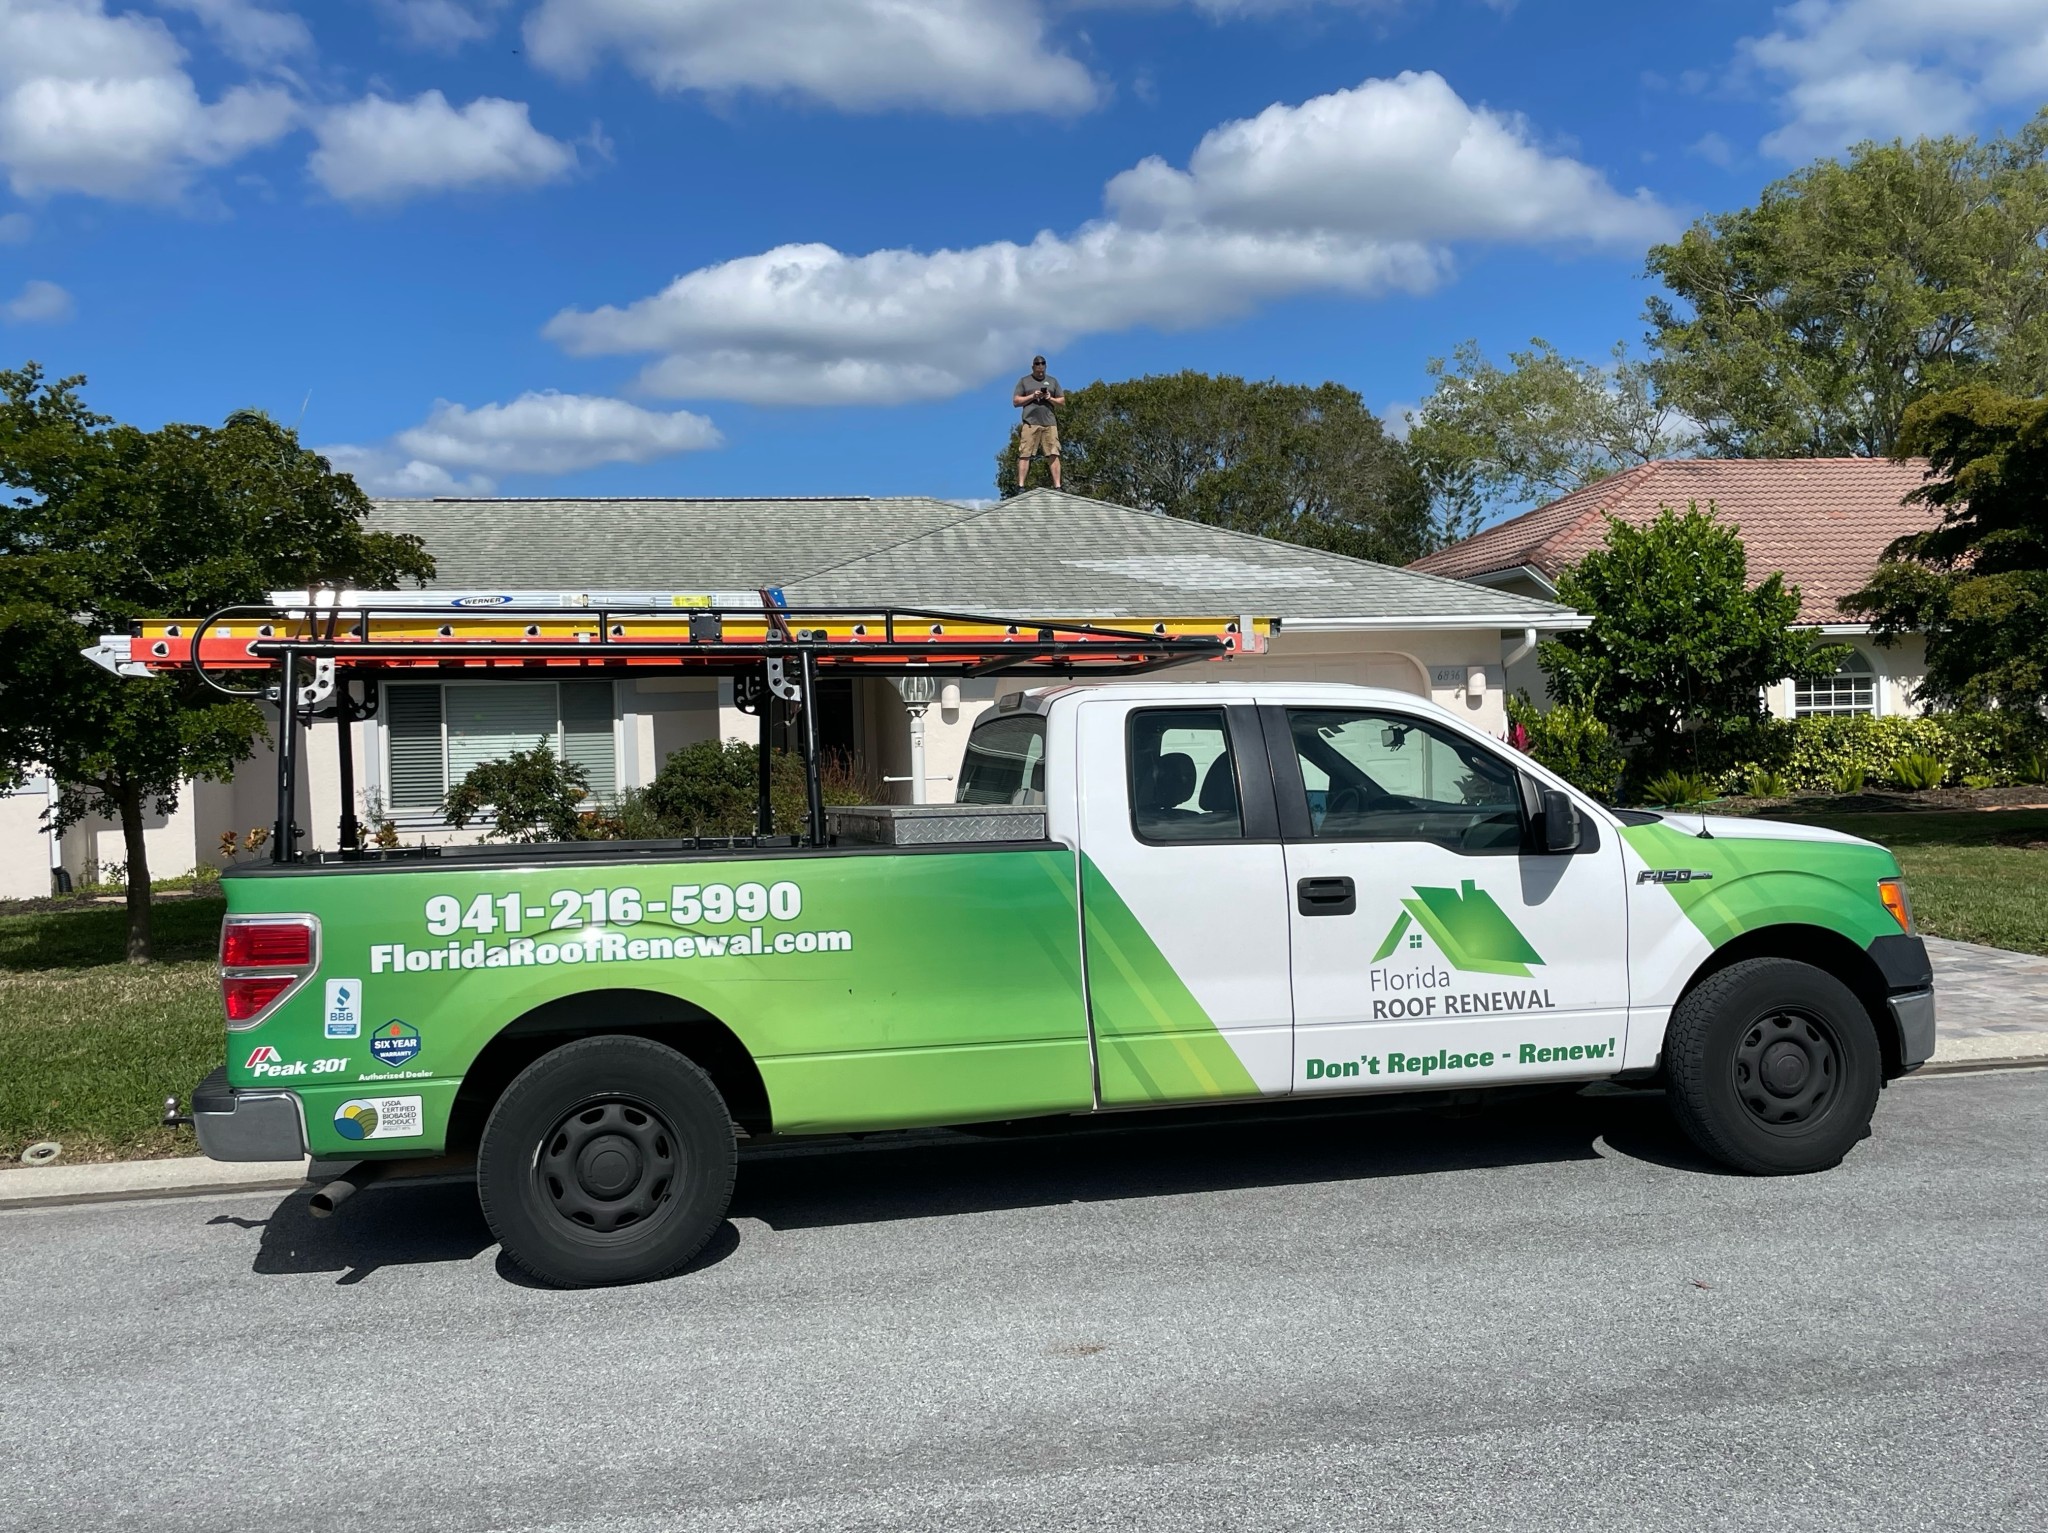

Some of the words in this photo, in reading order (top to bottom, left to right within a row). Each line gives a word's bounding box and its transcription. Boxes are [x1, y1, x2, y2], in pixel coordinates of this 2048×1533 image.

[464, 597, 501, 605] WERNER
[424, 881, 803, 937] 941-216-5990
[370, 926, 853, 974] FloridaRoofRenewal.com
[1370, 965, 1450, 992] Florida
[1373, 996, 1437, 1019] ROOF
[1444, 989, 1556, 1015] RENEWAL
[330, 1012, 354, 1021] BBB
[374, 1040, 391, 1050] SIX
[391, 1038, 418, 1048] YEAR
[380, 1050, 412, 1058] WARRANTY
[1306, 1054, 1380, 1080] Don't
[1387, 1049, 1495, 1075] Replace
[1518, 1037, 1616, 1064] Renew!
[253, 1060, 309, 1078] Peak
[358, 1071, 405, 1081] Authorized
[405, 1069, 434, 1079] Dealer
[382, 1100, 402, 1108] USDA
[382, 1105, 416, 1113] CERTIFIED
[382, 1111, 417, 1120] BIOBASED
[382, 1117, 416, 1126] PRODUCT
